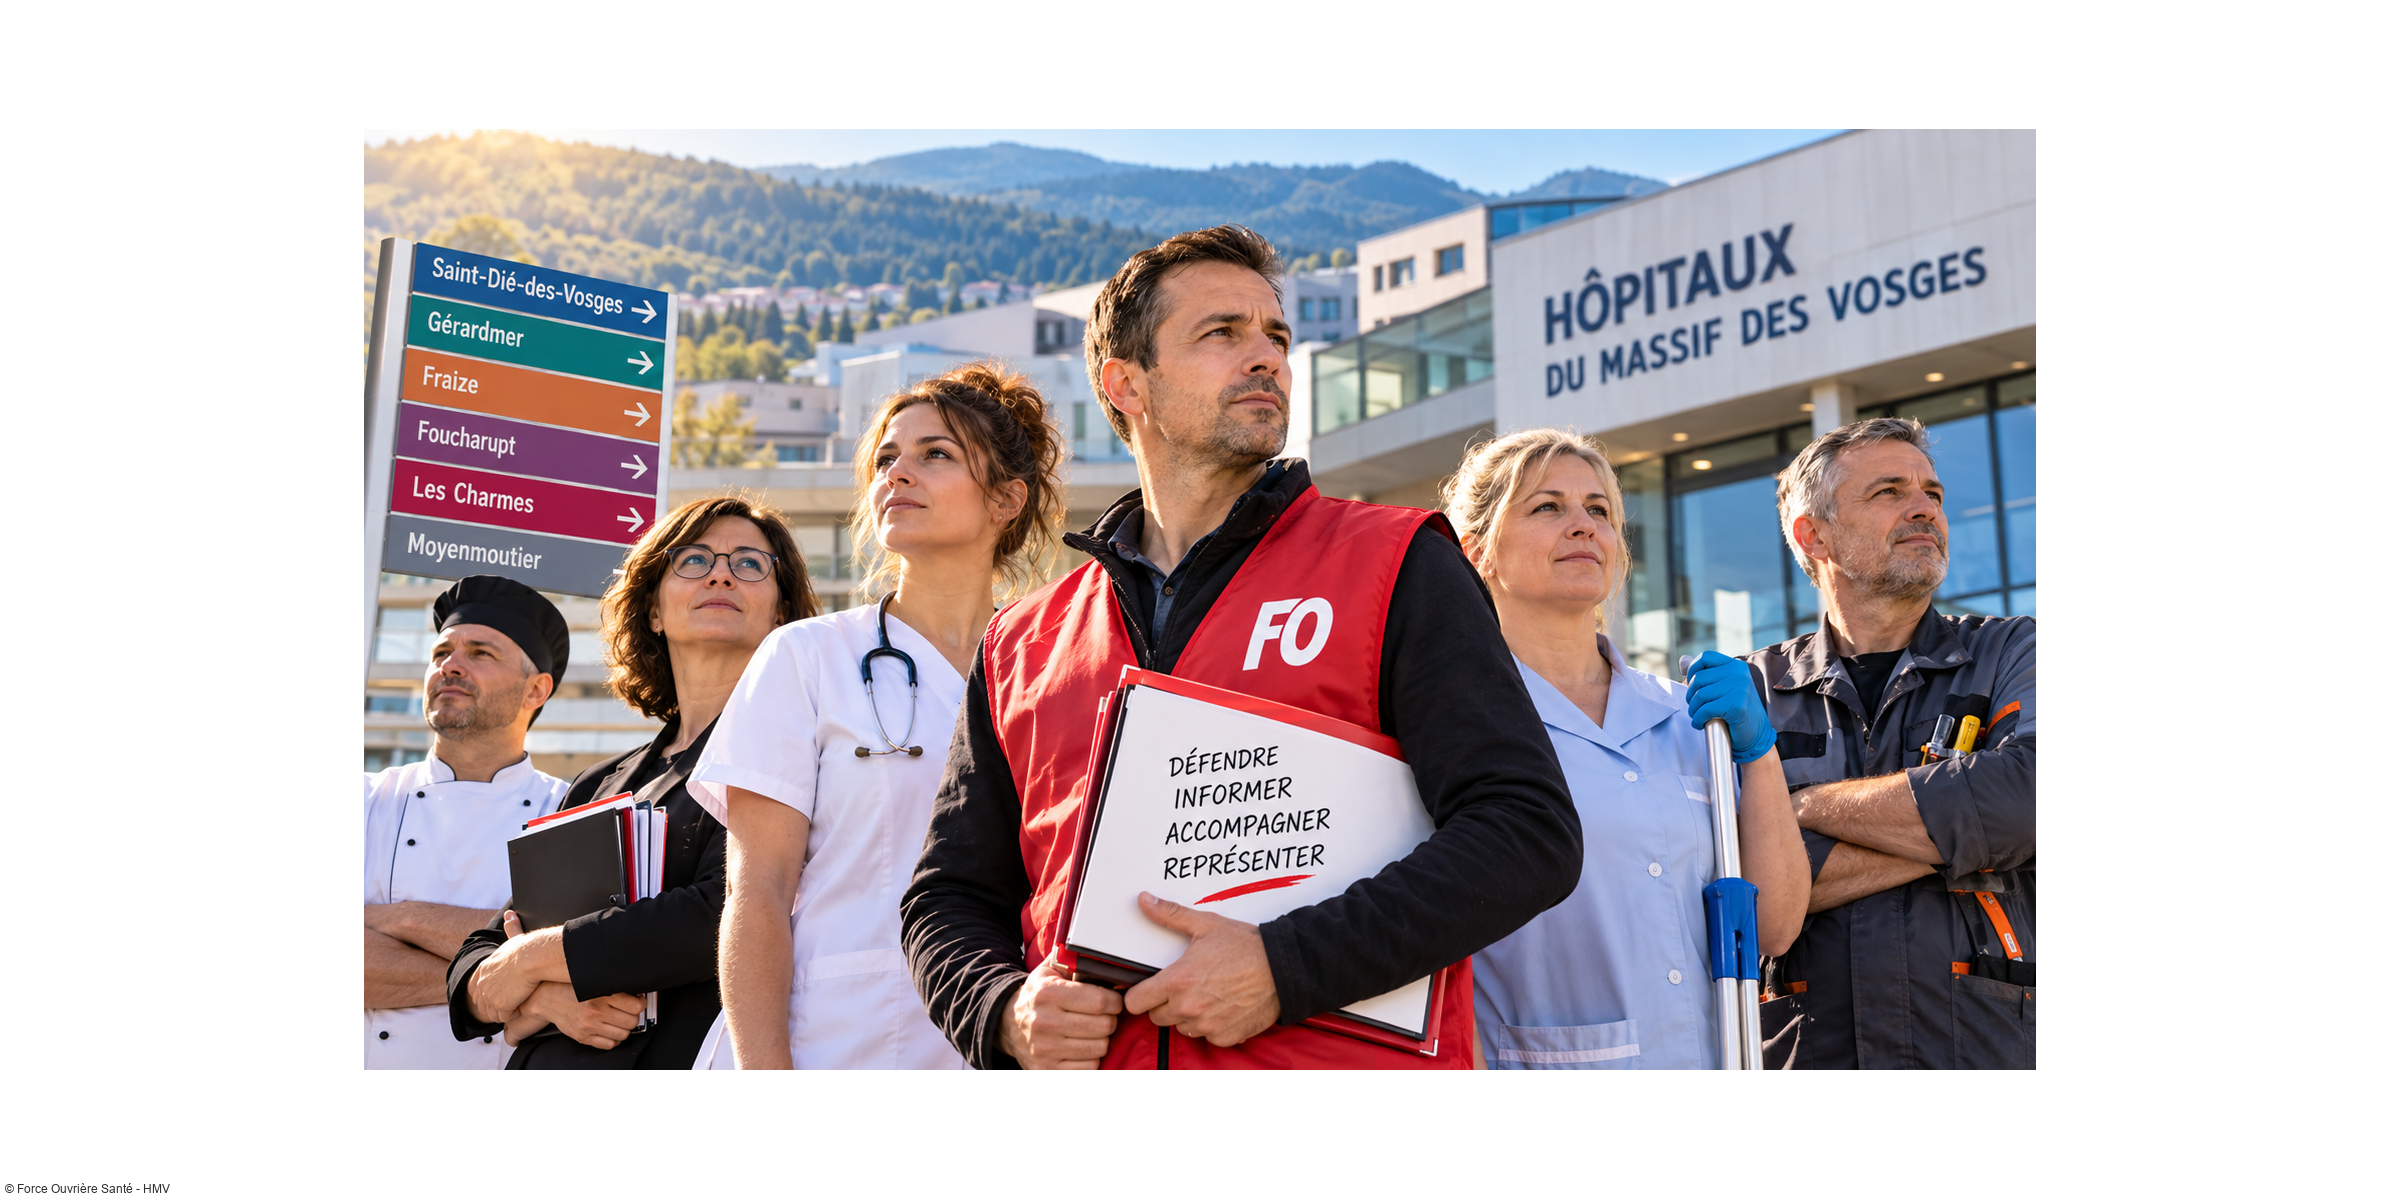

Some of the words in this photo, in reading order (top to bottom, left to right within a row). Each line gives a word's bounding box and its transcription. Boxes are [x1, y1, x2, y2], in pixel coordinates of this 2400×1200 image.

[431, 256, 624, 316] Saint-Dié-des-Vosges
[1544, 222, 1797, 346] HÔPITAUX
[427, 311, 524, 348] Gérardmer
[1546, 354, 1586, 397] DU
[1599, 316, 1723, 386] MASSIF
[1740, 294, 1810, 347] DES
[1827, 246, 1989, 322] VOSGES
[422, 365, 479, 395] Fraize
[417, 420, 516, 459] Foucharupt
[412, 476, 446, 501] Les
[453, 482, 534, 513] Charmes
[407, 532, 542, 570] Moyenmoutier
[1242, 597, 1334, 671] FO
[1169, 745, 1279, 777] DÉFENDRE
[1174, 776, 1293, 810] INFORMER
[1165, 807, 1331, 846] ACCOMPAGNER
[1163, 844, 1325, 880] REPRÉSENTER
